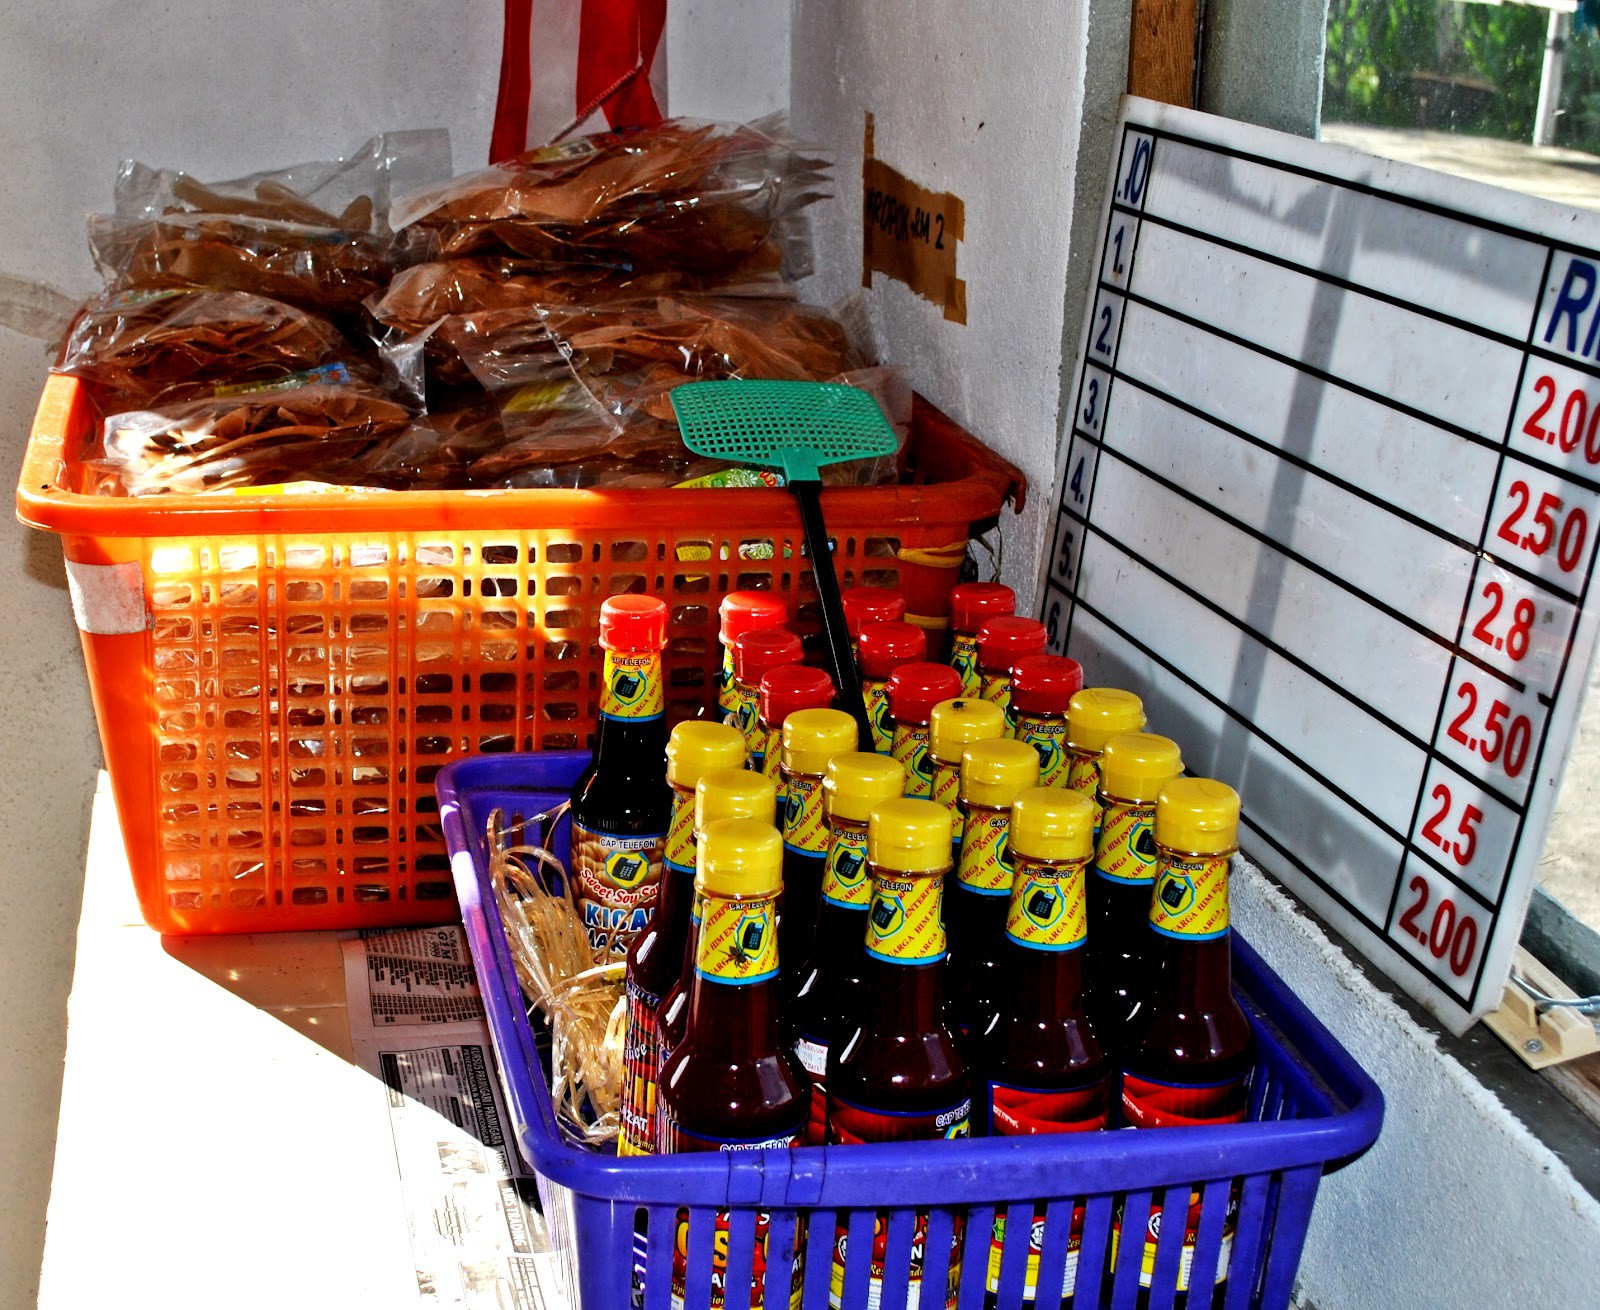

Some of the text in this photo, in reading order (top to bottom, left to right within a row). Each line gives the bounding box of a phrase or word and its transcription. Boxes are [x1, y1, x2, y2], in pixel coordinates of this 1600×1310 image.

[935, 213, 945, 250] 2
[1095, 306, 1112, 356] 2.
[1083, 379, 1098, 429] 3.
[1070, 456, 1085, 504] 4.
[1497, 480, 1587, 573] 2.50
[1058, 532, 1073, 581] 5.
[1472, 581, 1536, 661] 2.8
[622, 658, 650, 666] TELEFON
[1034, 725, 1064, 734] TELEFON
[1446, 682, 1531, 778] 2.50
[600, 838, 655, 849] CAP TELEFON
[1421, 784, 1482, 866] 2.5
[582, 869, 613, 899] Sweet
[614, 890, 638, 906] Soy
[879, 878, 912, 892] TELEFON
[585, 903, 655, 932] KICA
[1399, 875, 1479, 977] 2.00
[463, 1049, 478, 1092] PENERBANGAN
[474, 1098, 490, 1144] PELANCONGAN
[484, 1106, 502, 1145] PRAMUGARA
[936, 1111, 954, 1127] CAP
[507, 1207, 527, 1247] TRADING
